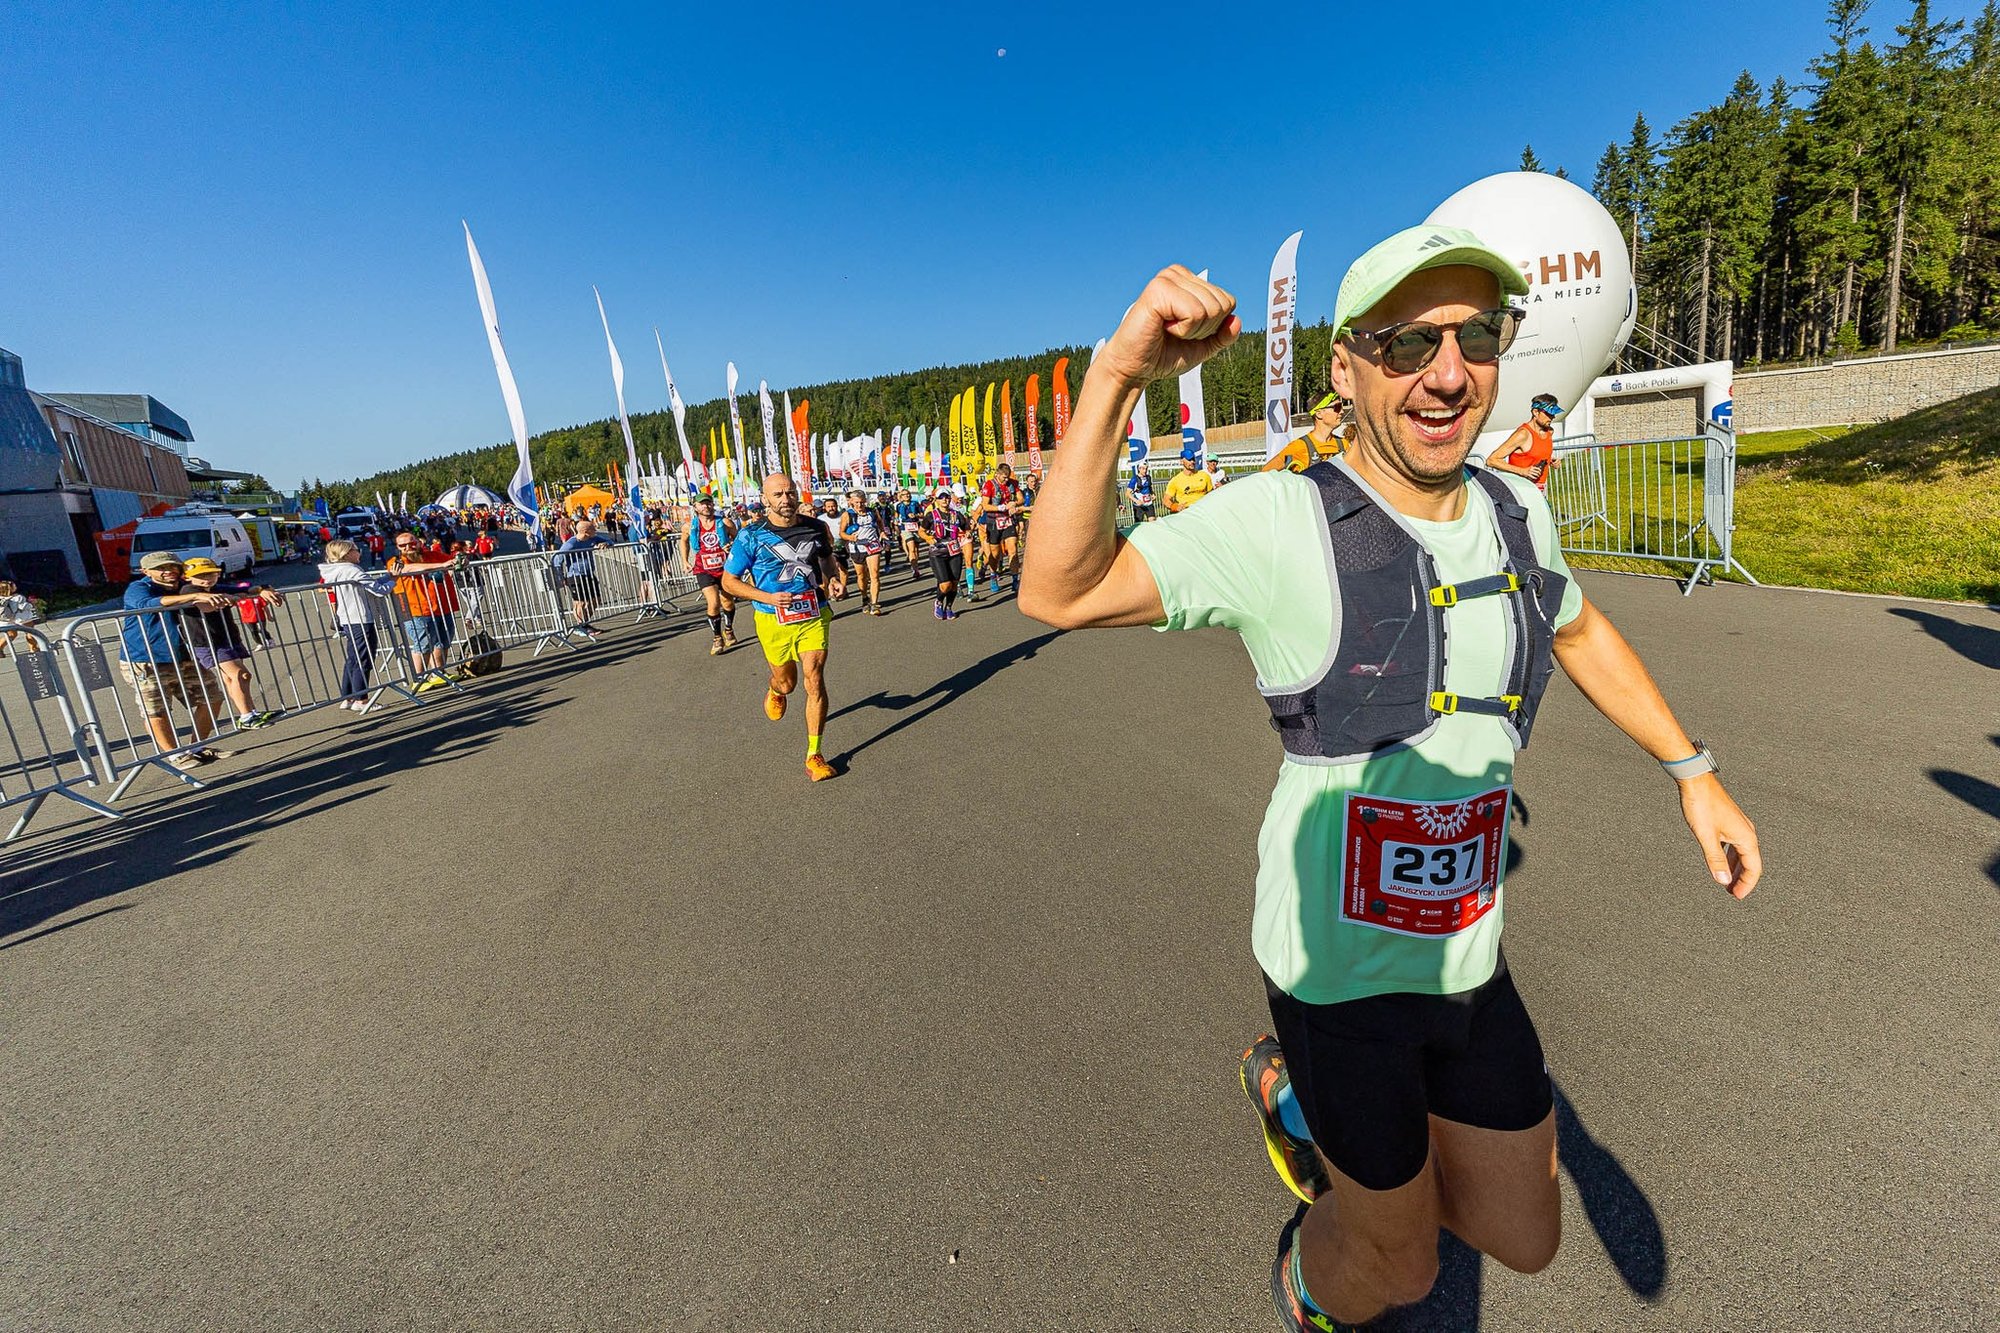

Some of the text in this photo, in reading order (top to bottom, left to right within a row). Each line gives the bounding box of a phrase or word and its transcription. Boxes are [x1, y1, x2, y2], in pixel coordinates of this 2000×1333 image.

[1509, 294, 1542, 306] SKA
[1270, 276, 1289, 386] KGHM
[1625, 380, 1649, 391] Bank
[1651, 377, 1679, 387] Polski
[1392, 840, 1479, 886] 237
[1387, 884, 1435, 897] JAKUSZYCKI
